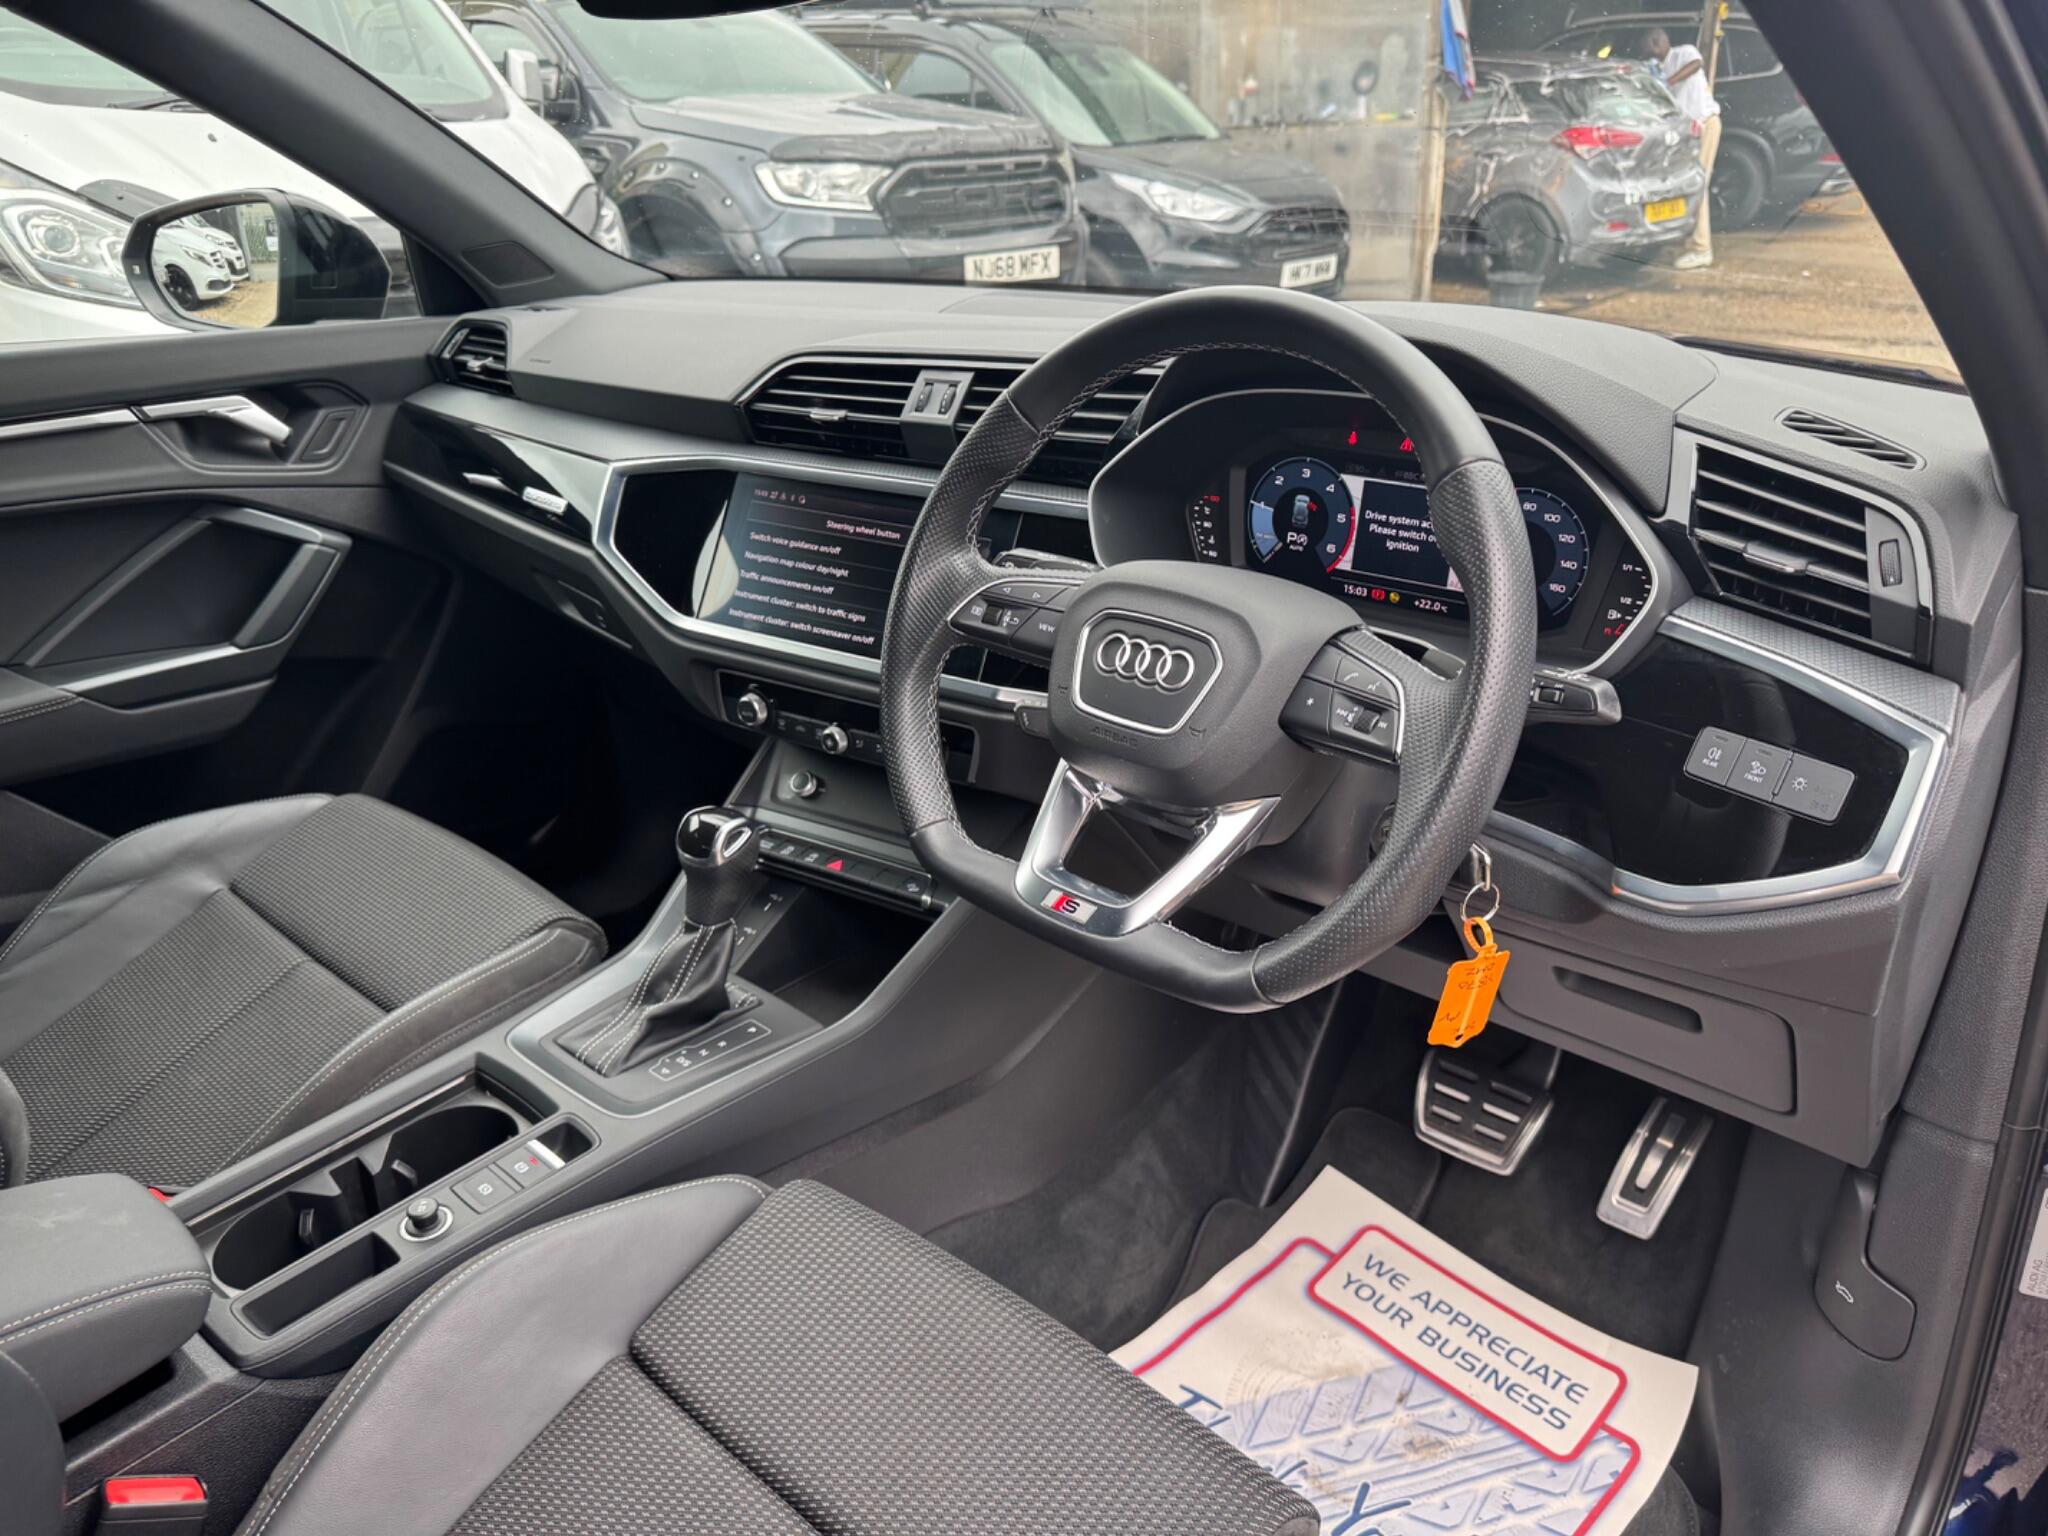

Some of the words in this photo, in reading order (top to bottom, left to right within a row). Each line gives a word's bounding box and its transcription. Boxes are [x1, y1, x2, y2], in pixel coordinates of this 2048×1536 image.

[1274, 475, 1284, 486] 2
[1302, 468, 1311, 478] 3
[1326, 483, 1335, 494] 4
[1336, 513, 1346, 523] 5
[1365, 510, 1387, 522] Drive
[1388, 515, 1419, 529] system
[826, 520, 854, 533] Steering
[855, 525, 876, 536] wheel
[876, 529, 901, 540] button
[1369, 523, 1396, 536] Please
[1398, 529, 1426, 542] switch
[750, 531, 771, 542] Switch
[772, 536, 788, 546] voice
[789, 538, 819, 550] guidance
[820, 545, 842, 555] on/off
[1326, 543, 1336, 554] 6
[744, 551, 779, 565] Navigation
[780, 559, 795, 568] map
[795, 561, 817, 571] colour
[817, 564, 849, 578] day/night
[740, 570, 759, 581] Traffic
[760, 575, 811, 589] announcements
[812, 583, 834, 595] on/off
[1343, 585, 1367, 597] 15:03
[734, 589, 770, 603] Instrument
[796, 600, 817, 613] switch
[818, 605, 826, 613] to
[827, 607, 848, 619] traffic
[849, 613, 866, 623] signs
[729, 608, 765, 623] Instrument
[790, 619, 812, 632] switch
[812, 626, 851, 641] screensaver
[852, 634, 875, 645] on/off
[1039, 622, 1055, 633] VIEW
[1363, 1253, 1411, 1291] WE
[1410, 1290, 1590, 1404] APPRECIATE
[1341, 1272, 1414, 1330] YOUR
[1417, 1325, 1572, 1430] BUSINESS
